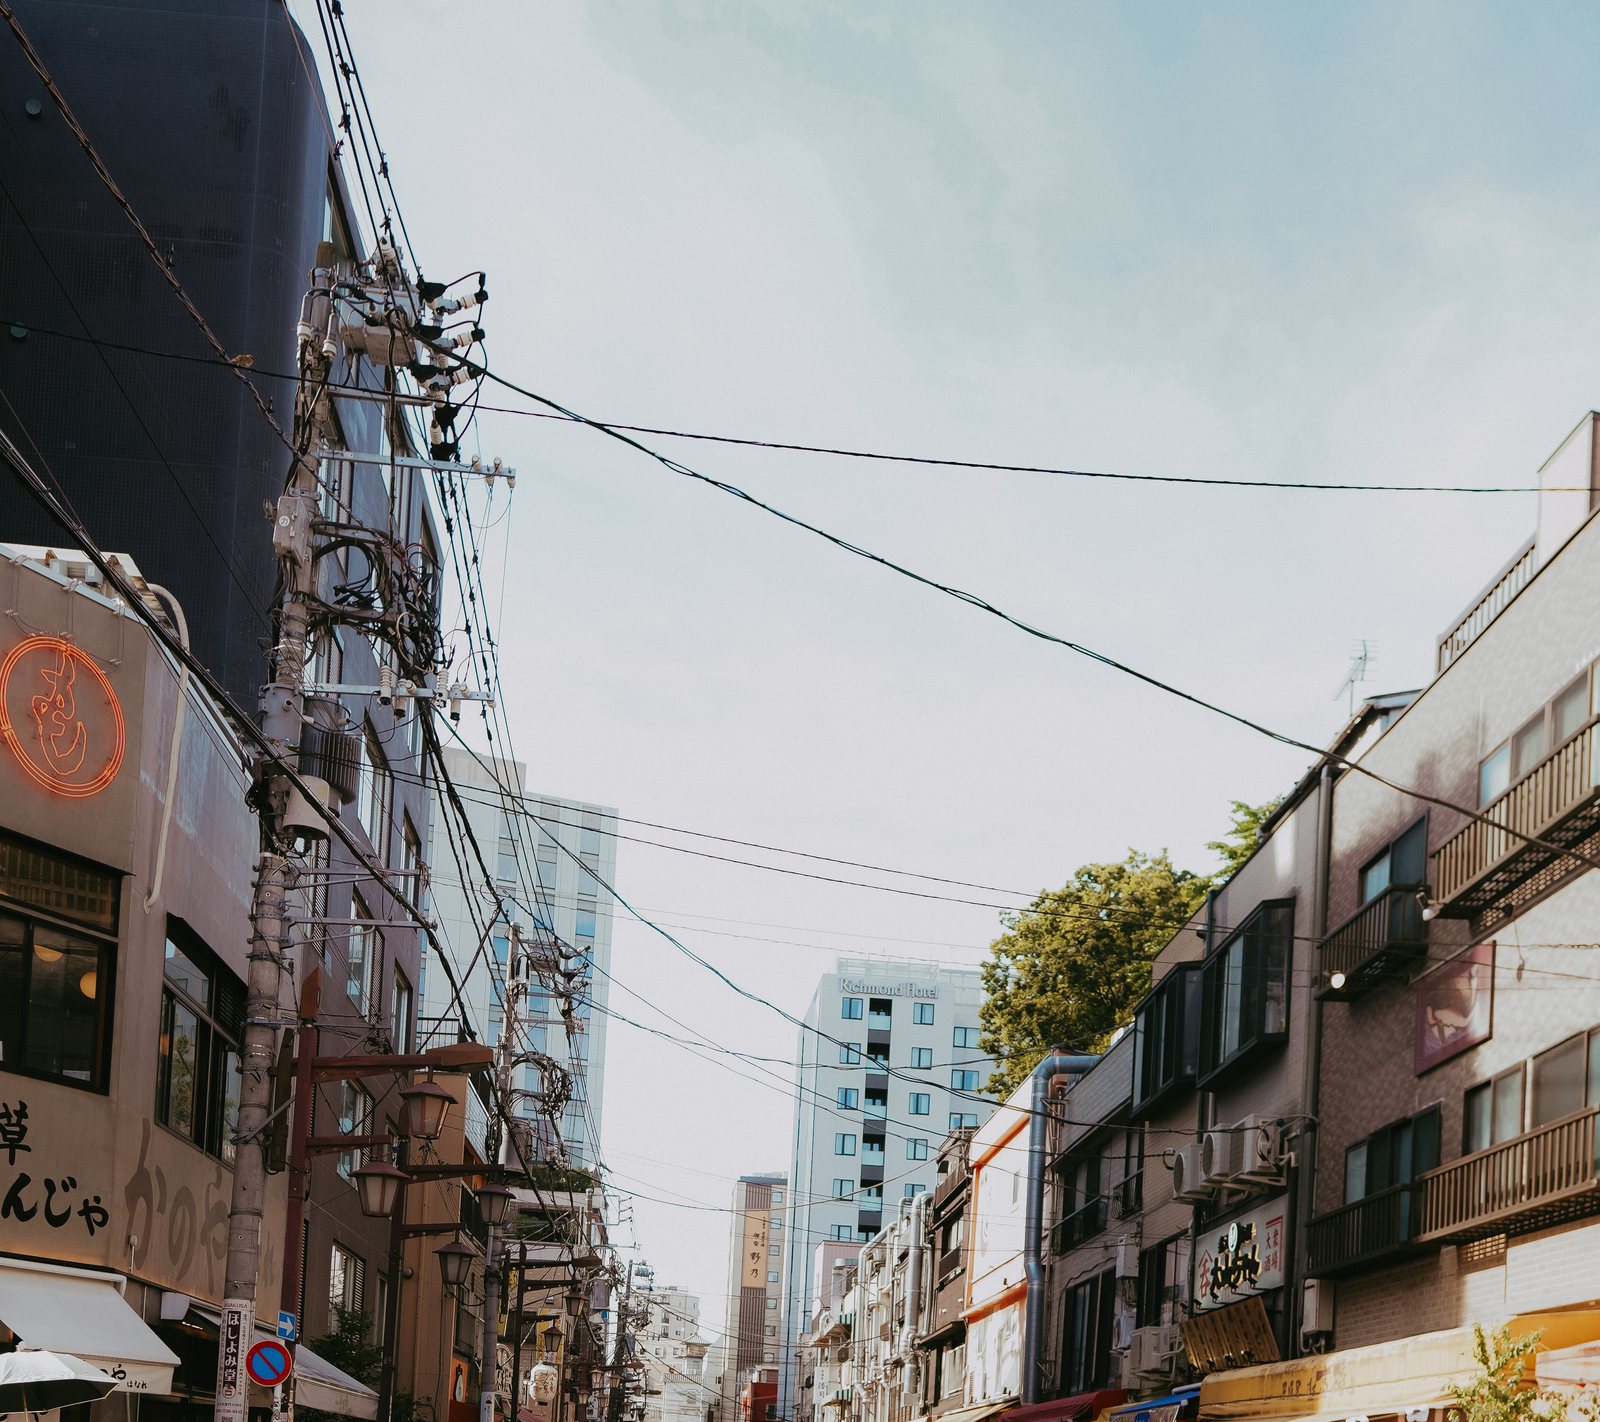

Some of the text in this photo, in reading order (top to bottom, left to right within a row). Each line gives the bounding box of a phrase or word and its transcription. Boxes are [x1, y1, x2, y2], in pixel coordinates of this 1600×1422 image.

[840, 979, 938, 999] Richmond Hotel
[1, 1172, 110, 1237] んじゃ
[224, 1312, 240, 1382] ほしよみ堂
